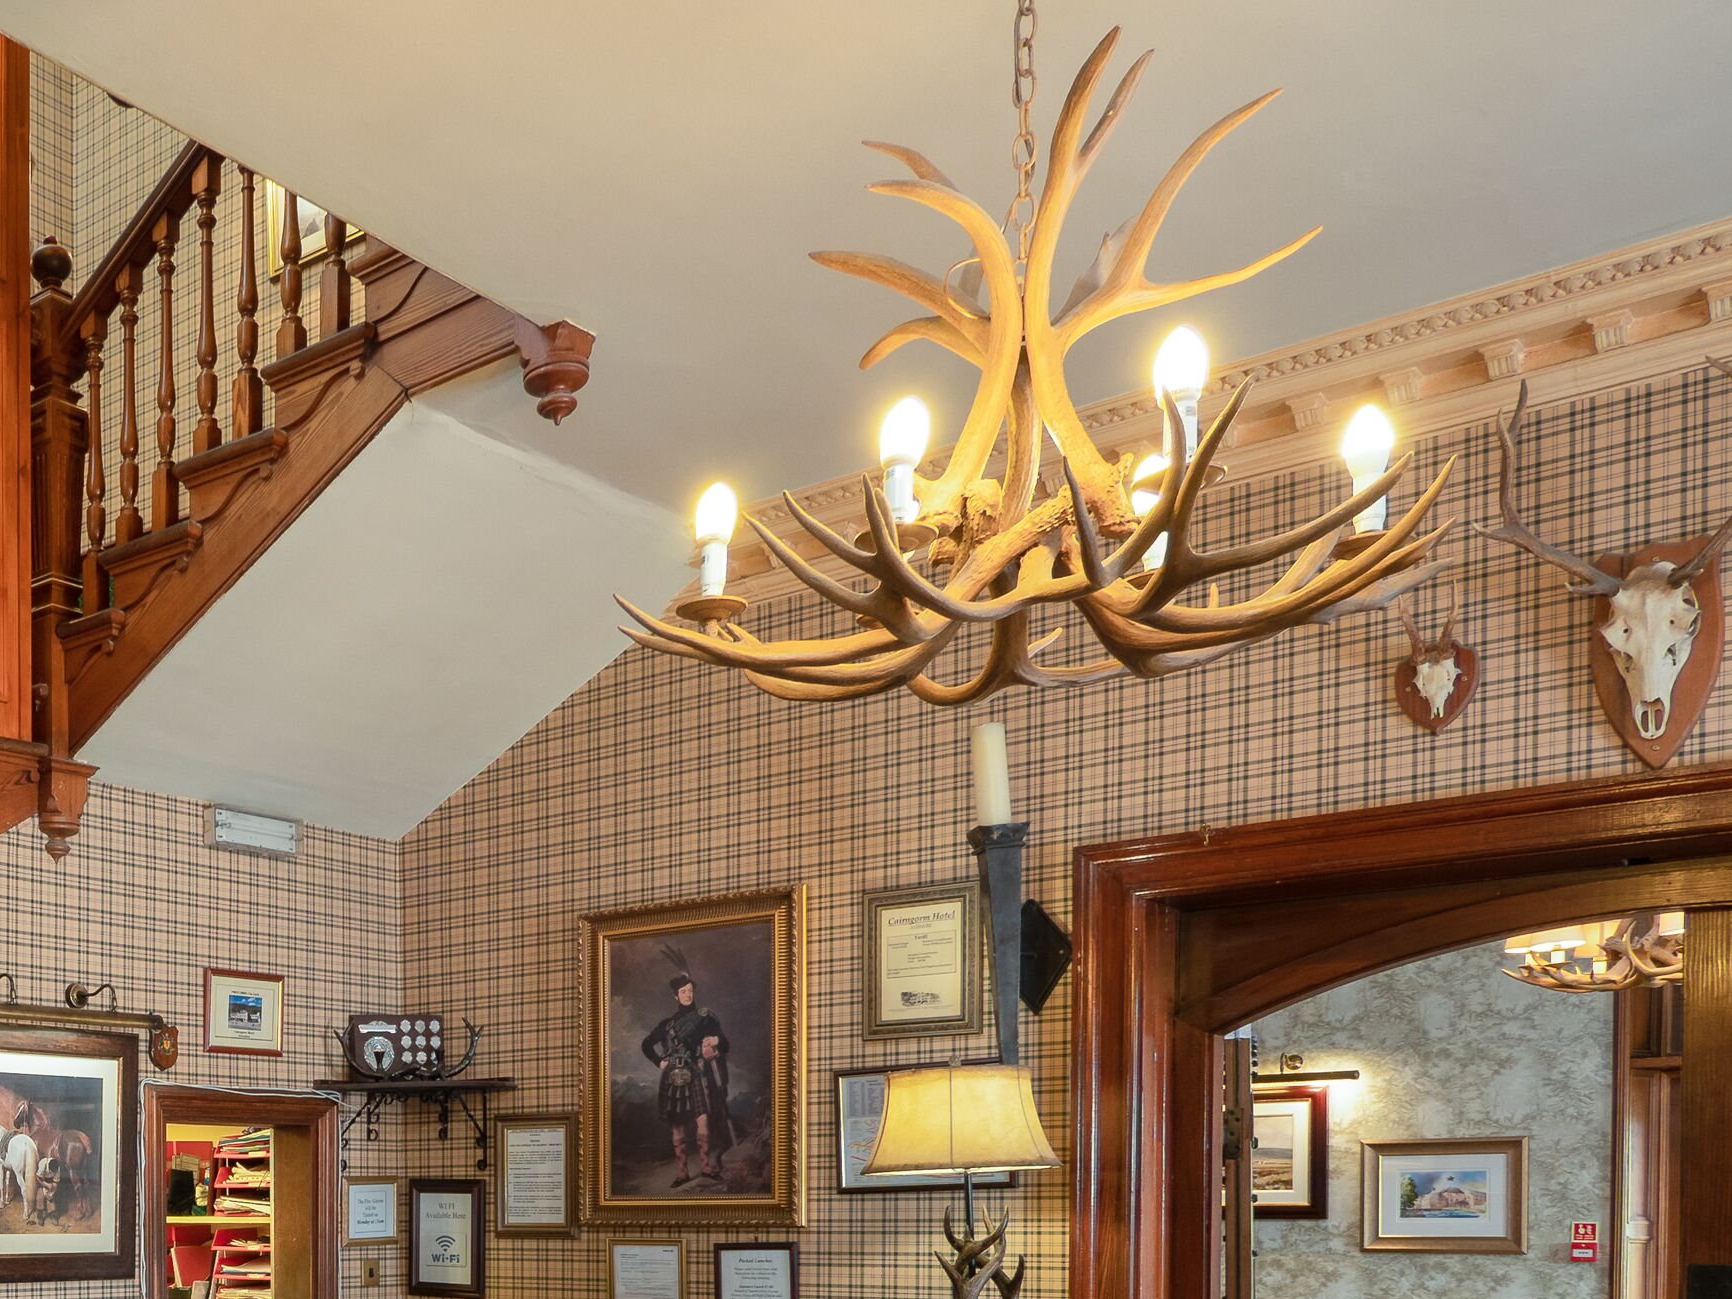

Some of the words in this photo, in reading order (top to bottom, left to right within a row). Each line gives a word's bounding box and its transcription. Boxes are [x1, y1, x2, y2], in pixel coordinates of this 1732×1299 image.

[888, 915, 930, 926] Cairngorm
[932, 910, 956, 920] Hotel
[425, 1211, 451, 1219] Available
